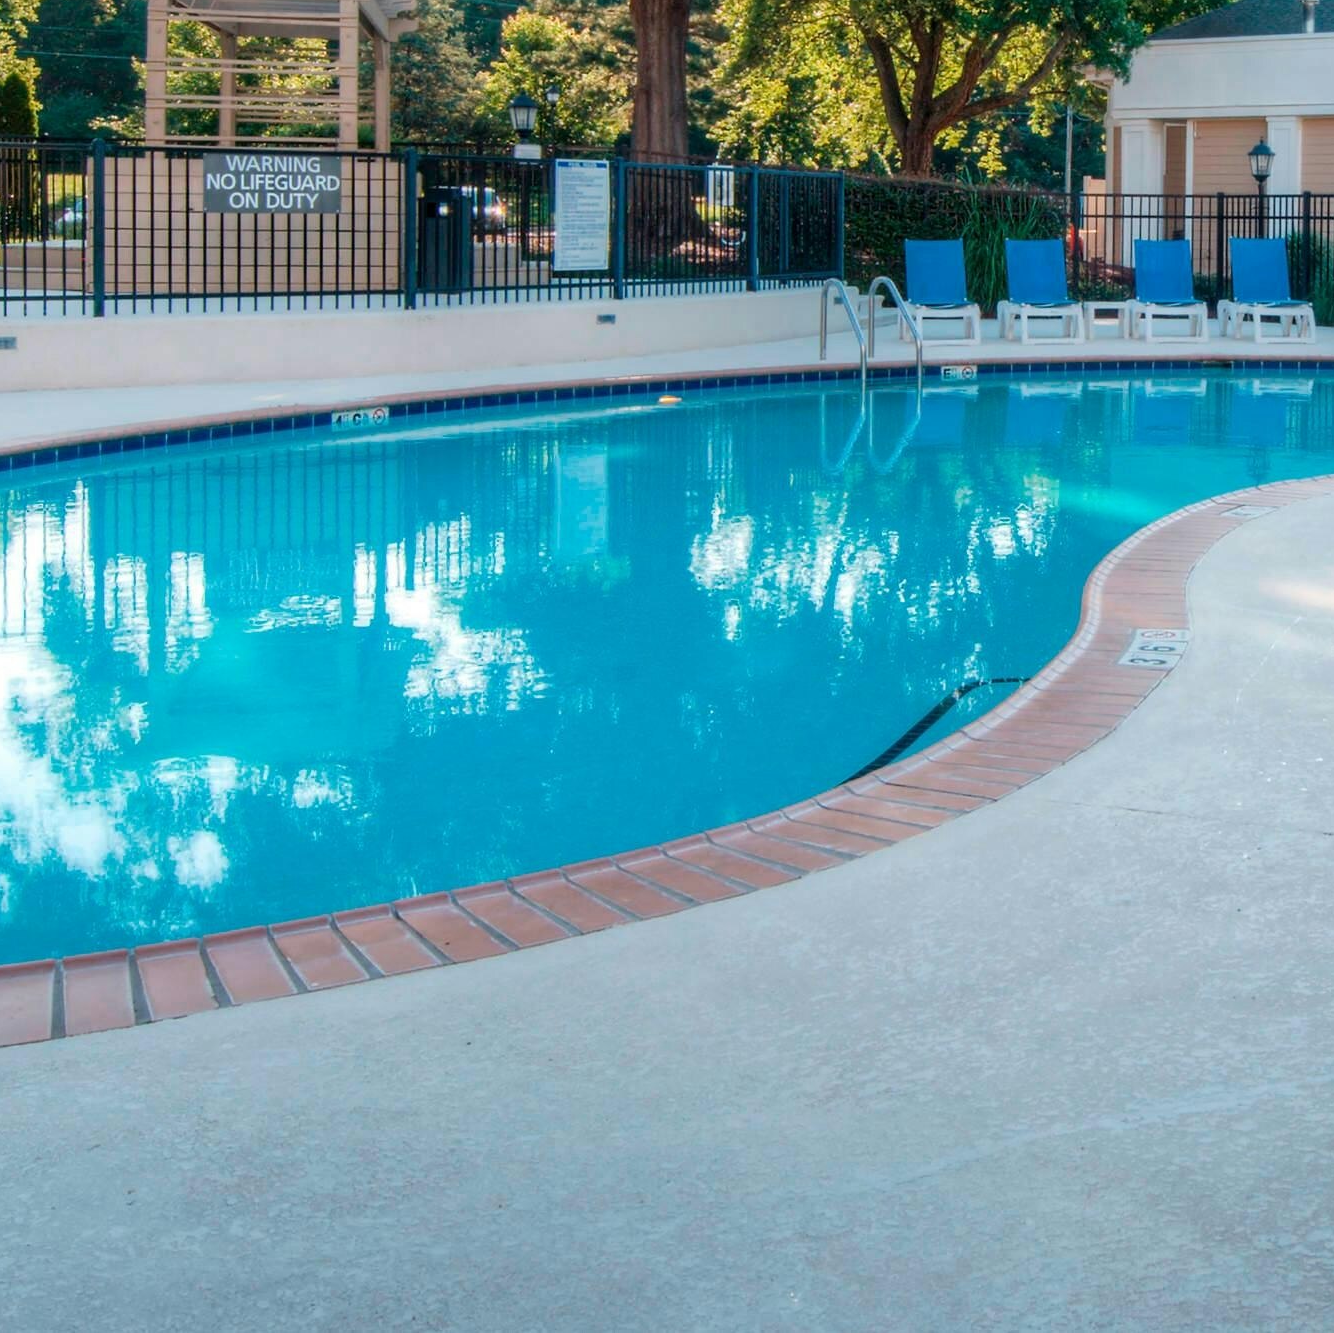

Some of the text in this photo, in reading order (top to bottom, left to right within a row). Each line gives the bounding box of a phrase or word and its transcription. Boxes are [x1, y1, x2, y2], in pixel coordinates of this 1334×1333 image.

[226, 155, 321, 173] WARNING
[206, 174, 340, 192] NO LIFEGUARD
[229, 192, 319, 209] ON DUTY
